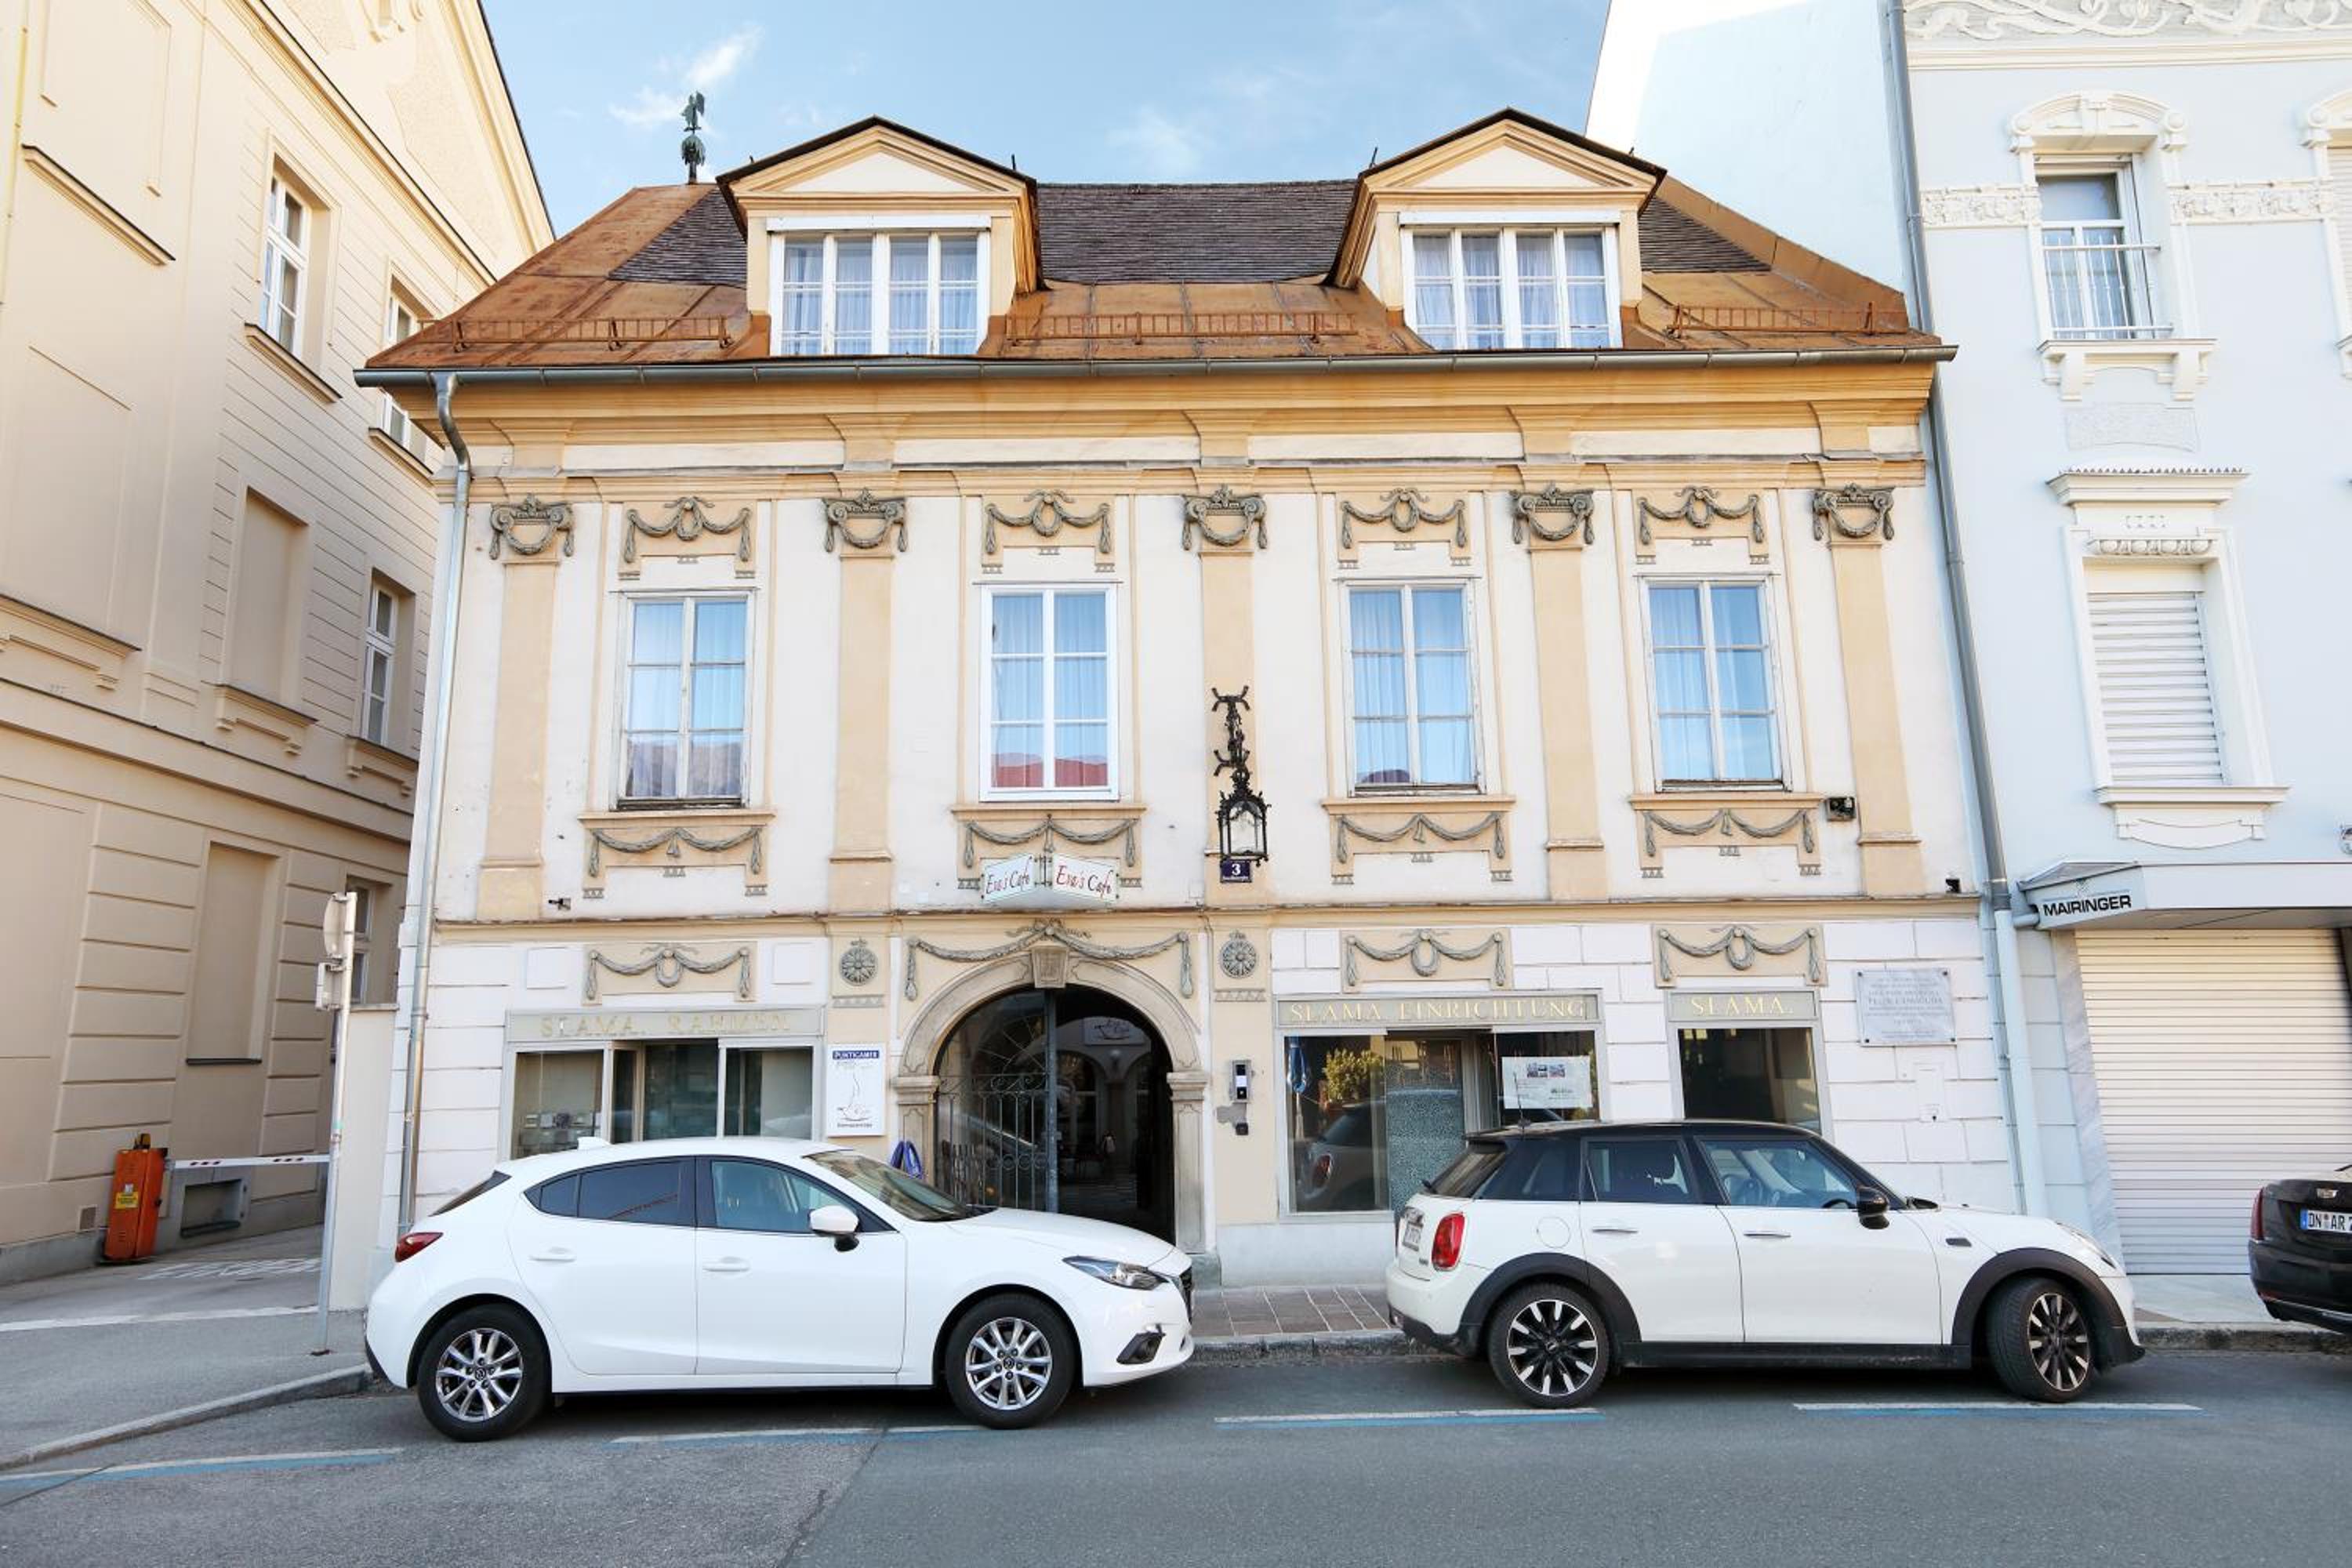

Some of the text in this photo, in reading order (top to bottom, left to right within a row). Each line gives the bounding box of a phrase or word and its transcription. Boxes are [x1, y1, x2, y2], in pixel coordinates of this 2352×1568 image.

[1232, 863, 1241, 876] 3
[2043, 895, 2132, 916] MAIRINGER
[1290, 997, 1585, 1022] SLAMA EINRICHTUNG
[1690, 996, 1784, 1015] SLAMA
[2331, 1214, 2345, 1230] AR
